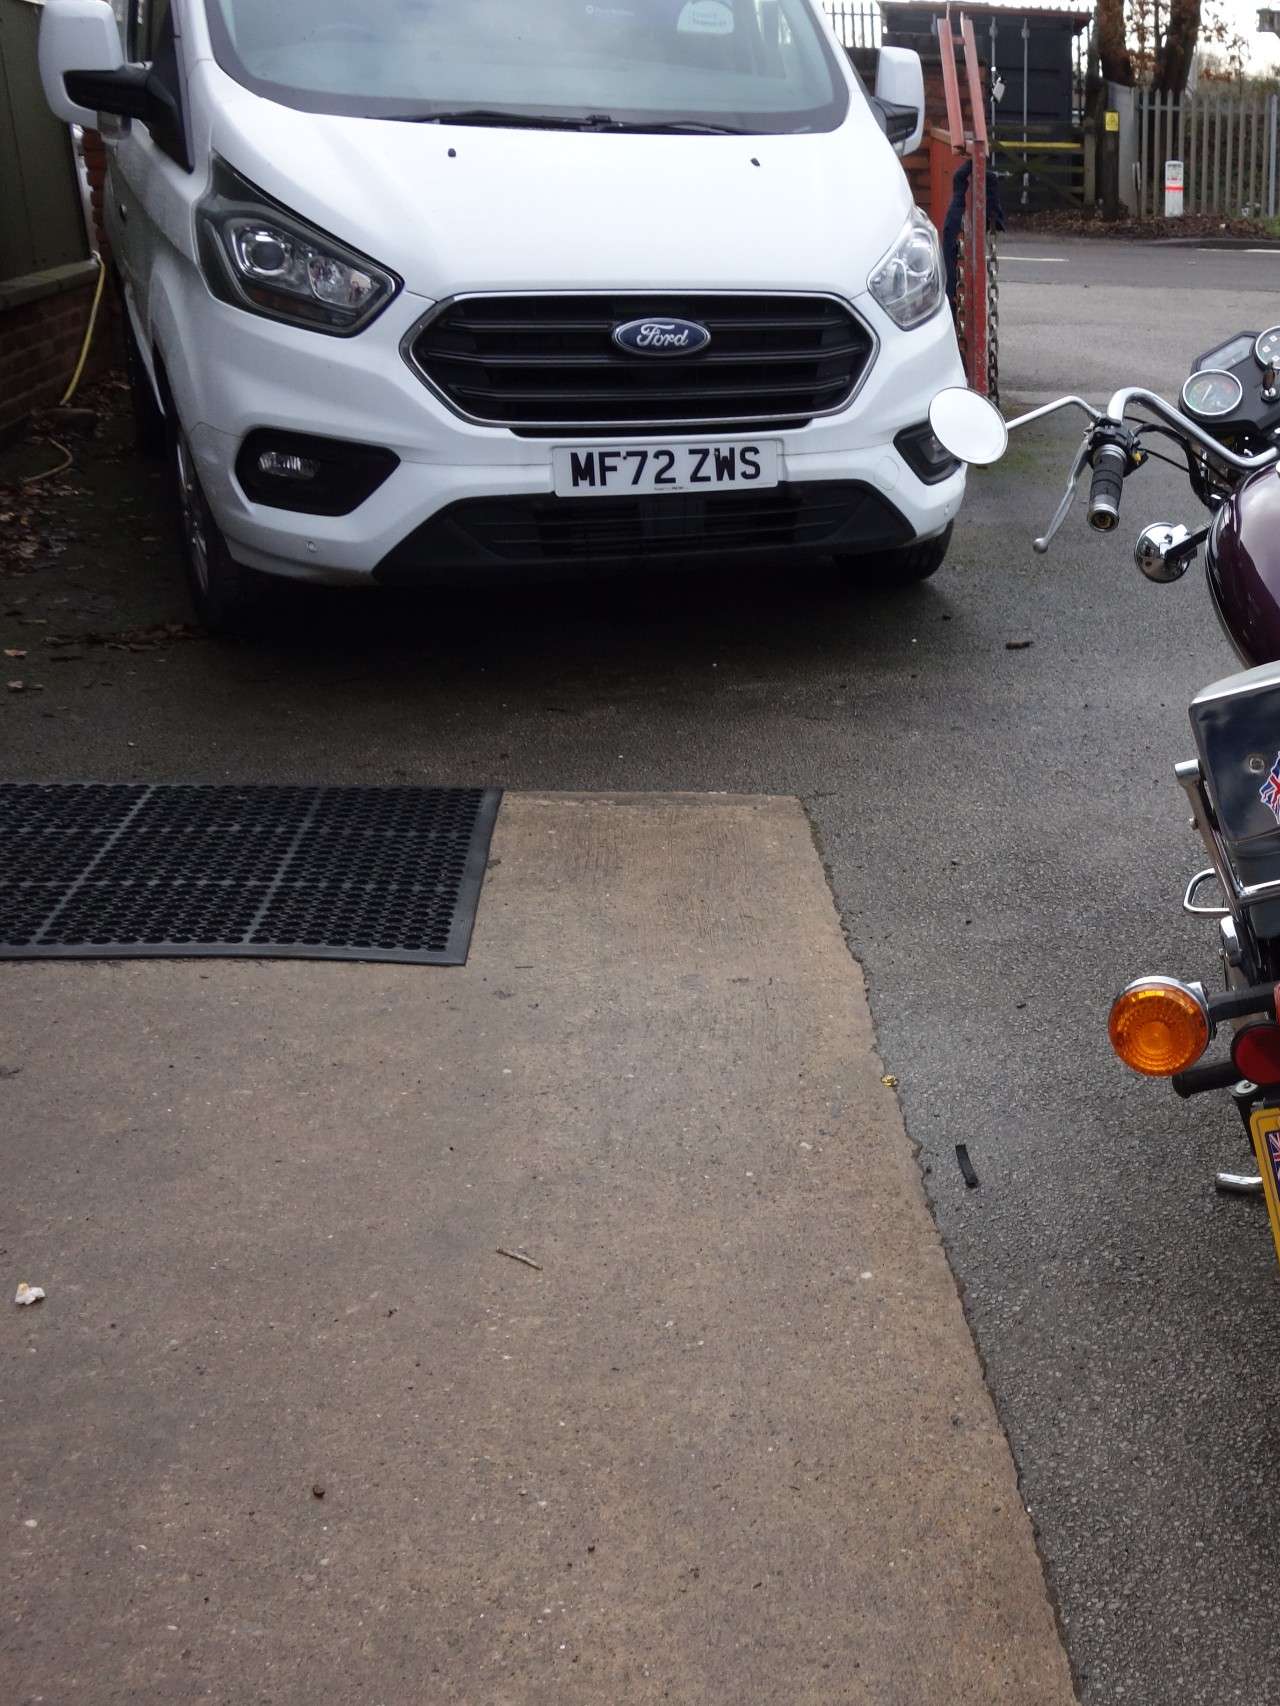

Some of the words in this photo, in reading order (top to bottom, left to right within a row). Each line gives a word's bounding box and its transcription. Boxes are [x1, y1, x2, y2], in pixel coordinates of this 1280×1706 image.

[636, 323, 689, 347] Ford
[570, 450, 677, 487] MF72
[688, 446, 761, 483] ZWS
